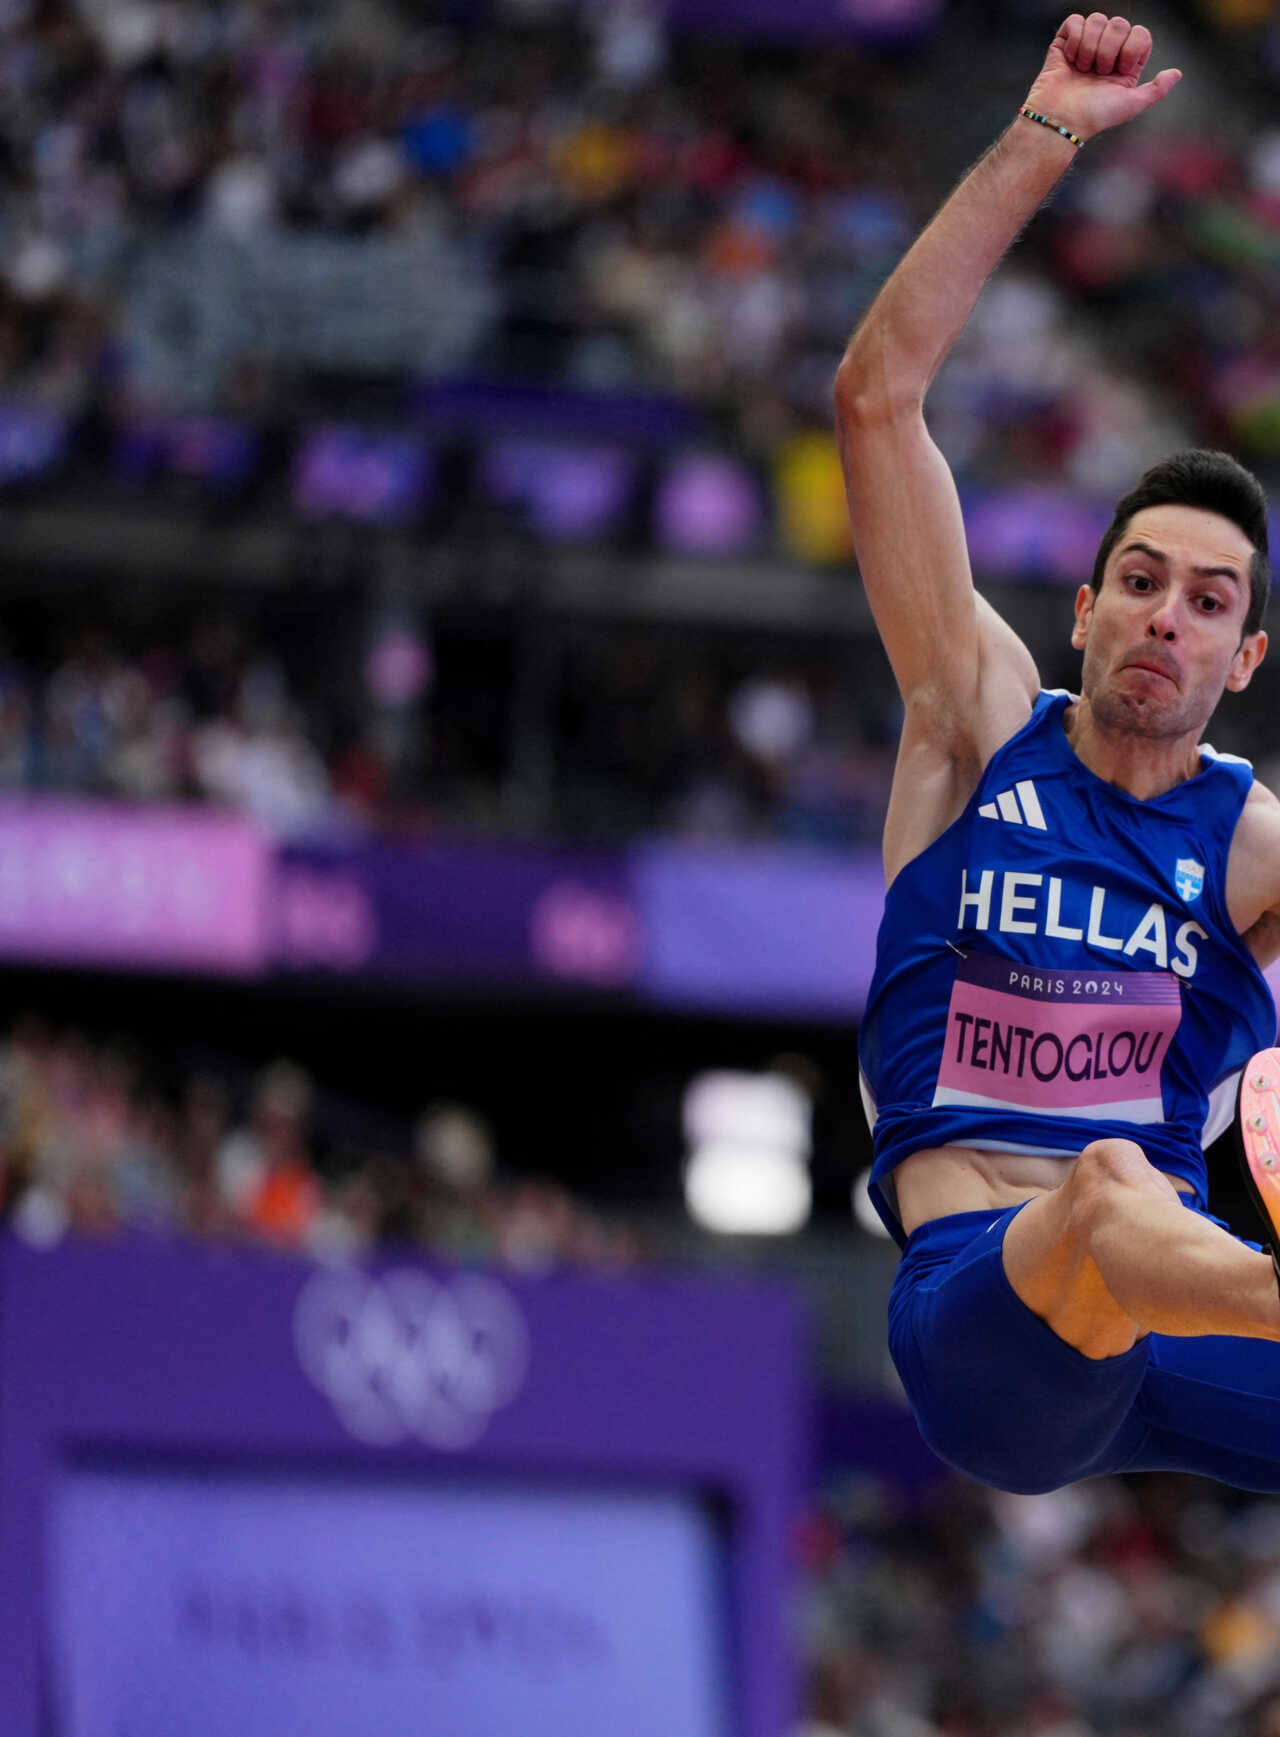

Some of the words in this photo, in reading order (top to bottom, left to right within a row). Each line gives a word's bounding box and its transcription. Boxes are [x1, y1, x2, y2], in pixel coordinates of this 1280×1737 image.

[957, 869, 1209, 978] HELLAS
[1009, 971, 1065, 994] PARIS
[1072, 980, 1123, 996] 2024
[955, 1012, 1164, 1083] TENTOGLOU
